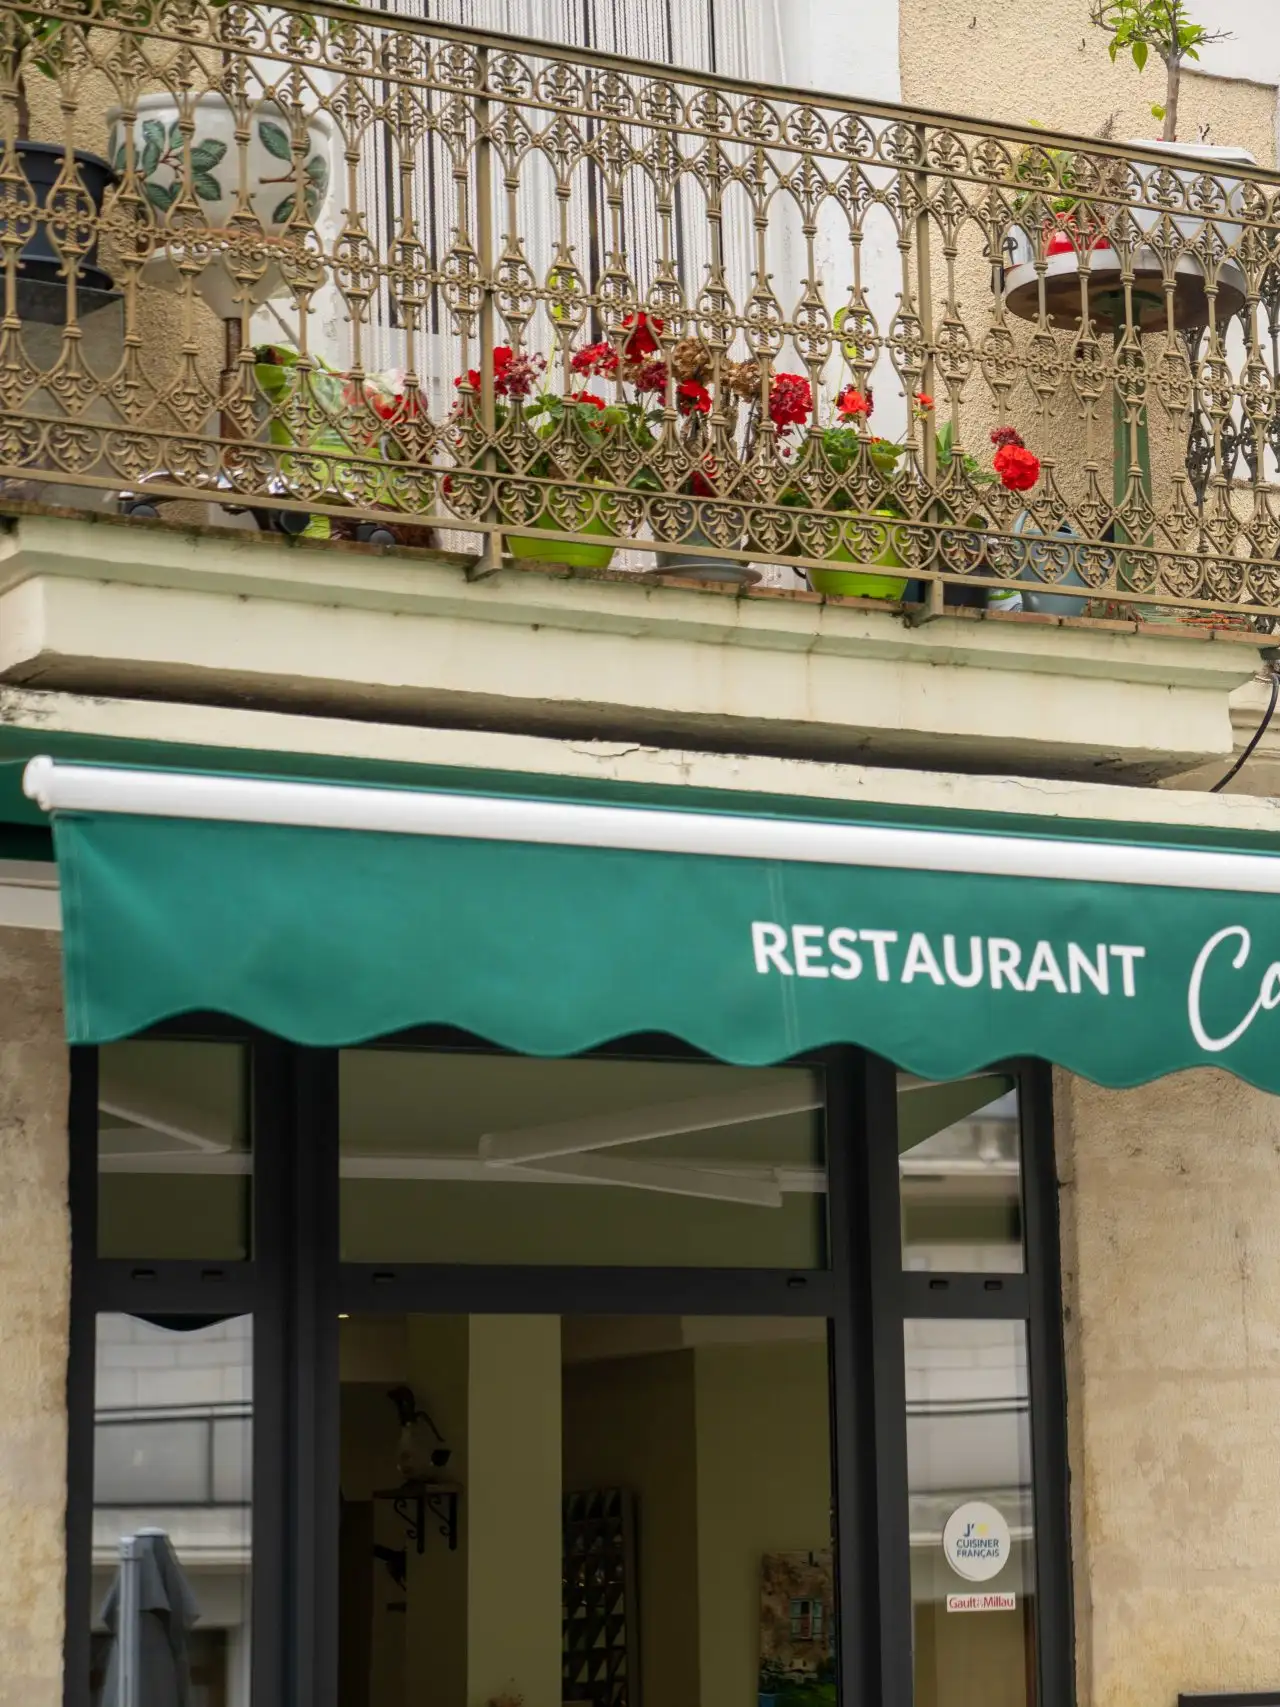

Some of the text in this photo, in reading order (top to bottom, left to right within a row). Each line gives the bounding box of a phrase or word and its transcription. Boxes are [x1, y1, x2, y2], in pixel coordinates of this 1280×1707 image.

[751, 921, 1146, 997] RESTAURANT
[956, 1539, 999, 1548] CUISINER
[956, 1549, 999, 1558] FRANÇAIS
